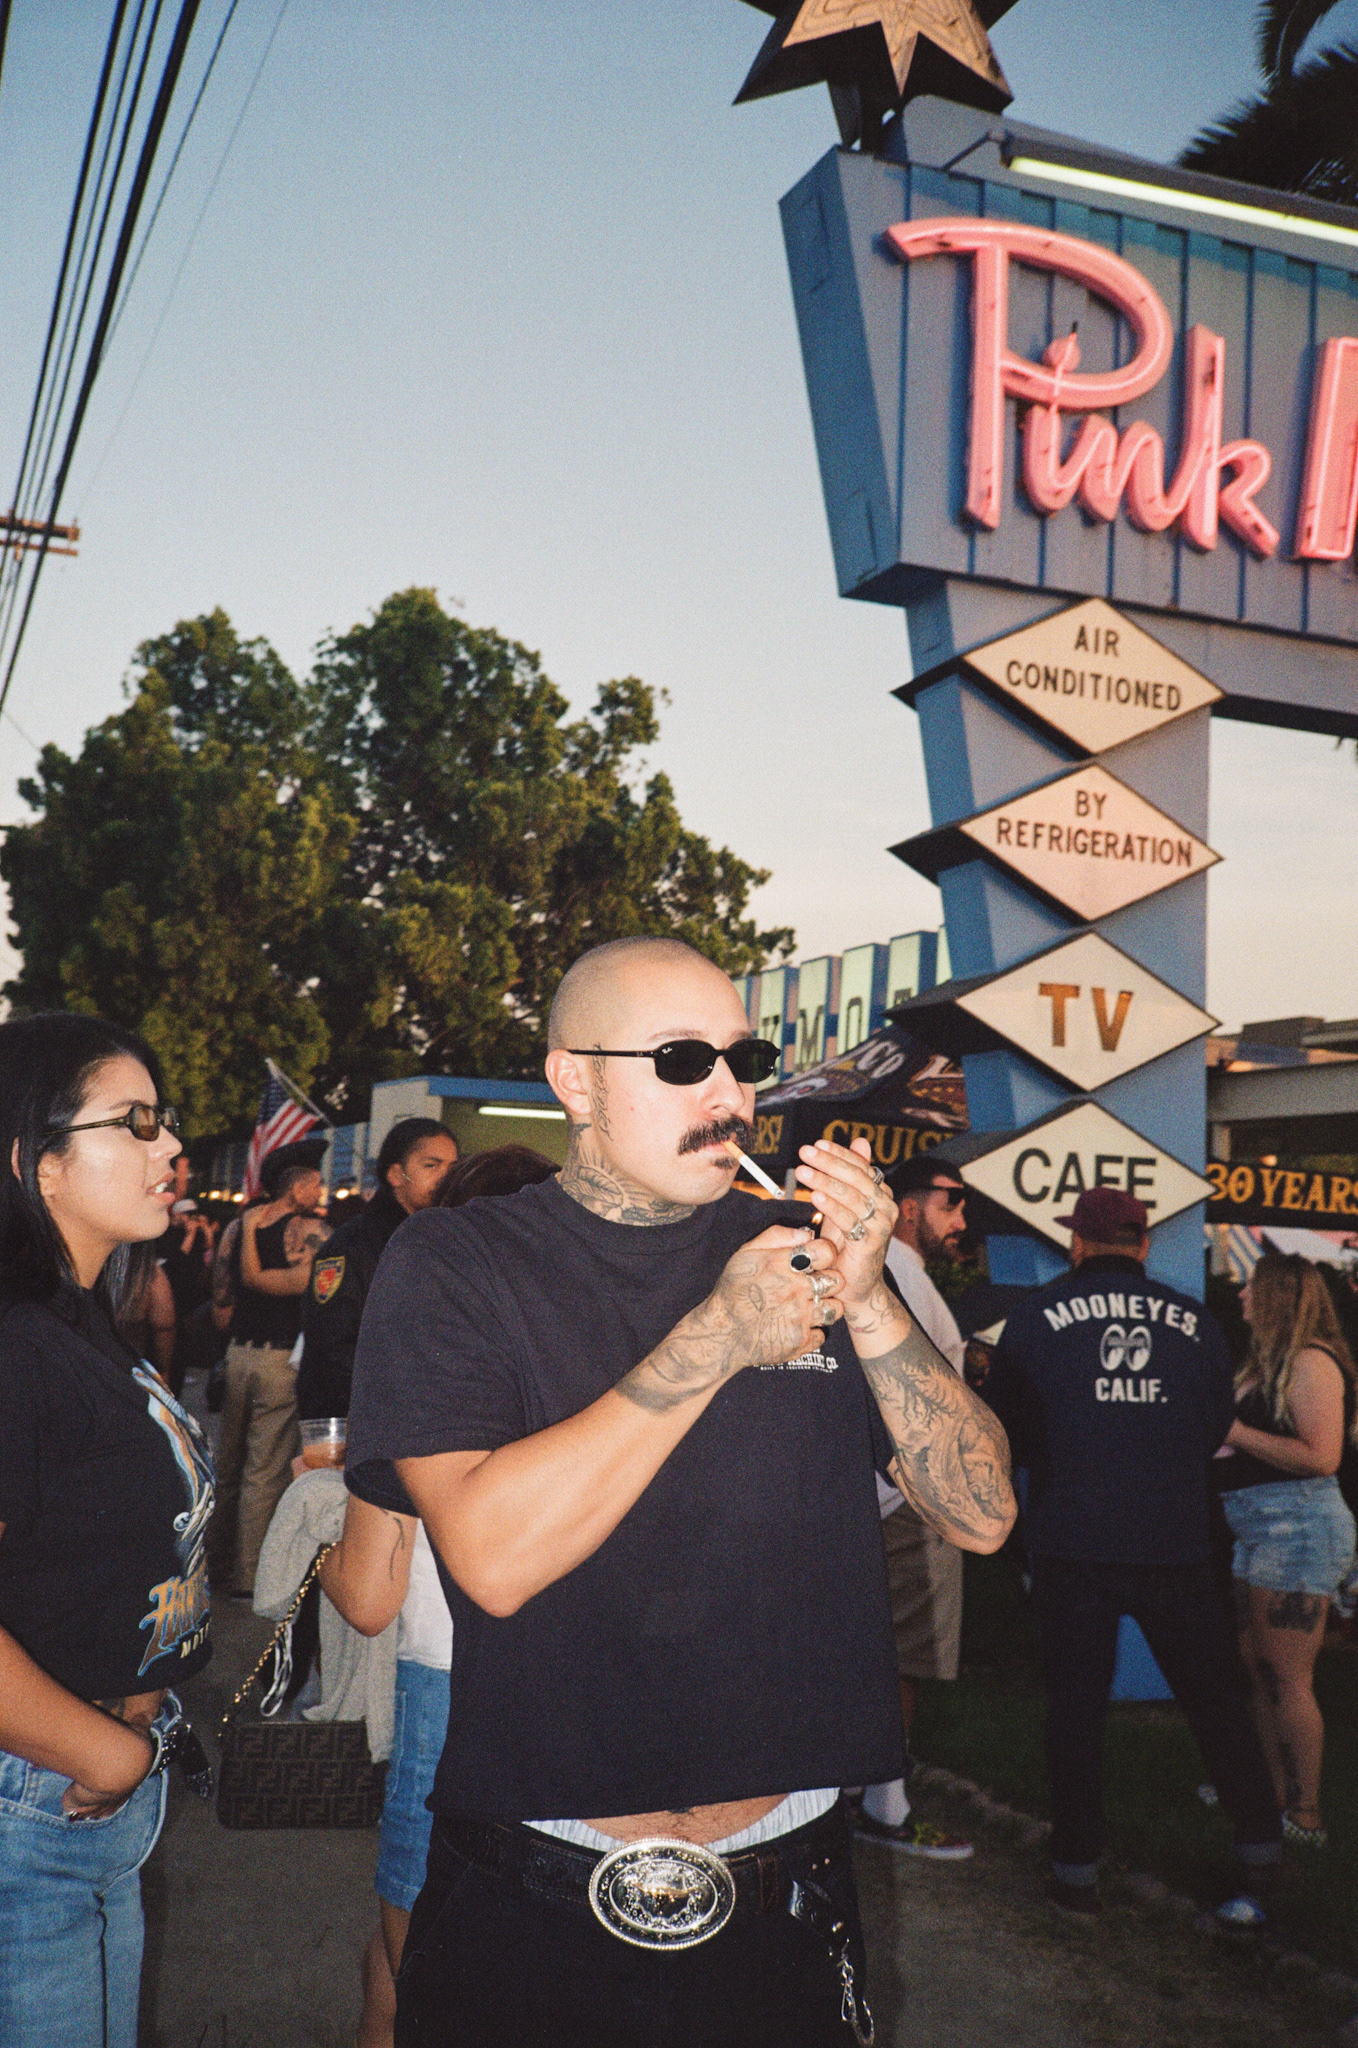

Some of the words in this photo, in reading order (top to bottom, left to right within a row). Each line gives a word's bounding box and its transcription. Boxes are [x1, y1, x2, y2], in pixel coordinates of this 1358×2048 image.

[885, 216, 1280, 557] Pink
[1074, 625, 1120, 659] AIR
[1005, 660, 1182, 711] CONDITIONED
[1075, 789, 1107, 820] BY
[996, 817, 1194, 868] REFRIGERATION
[1038, 981, 1134, 1052] TV
[1012, 1147, 1157, 1209] CAFE
[1206, 1163, 1255, 1203] 30
[1043, 1292, 1198, 1337] MOONEYES
[826, 1357, 839, 1370] CO.
[1095, 1377, 1168, 1403] CALIF.
